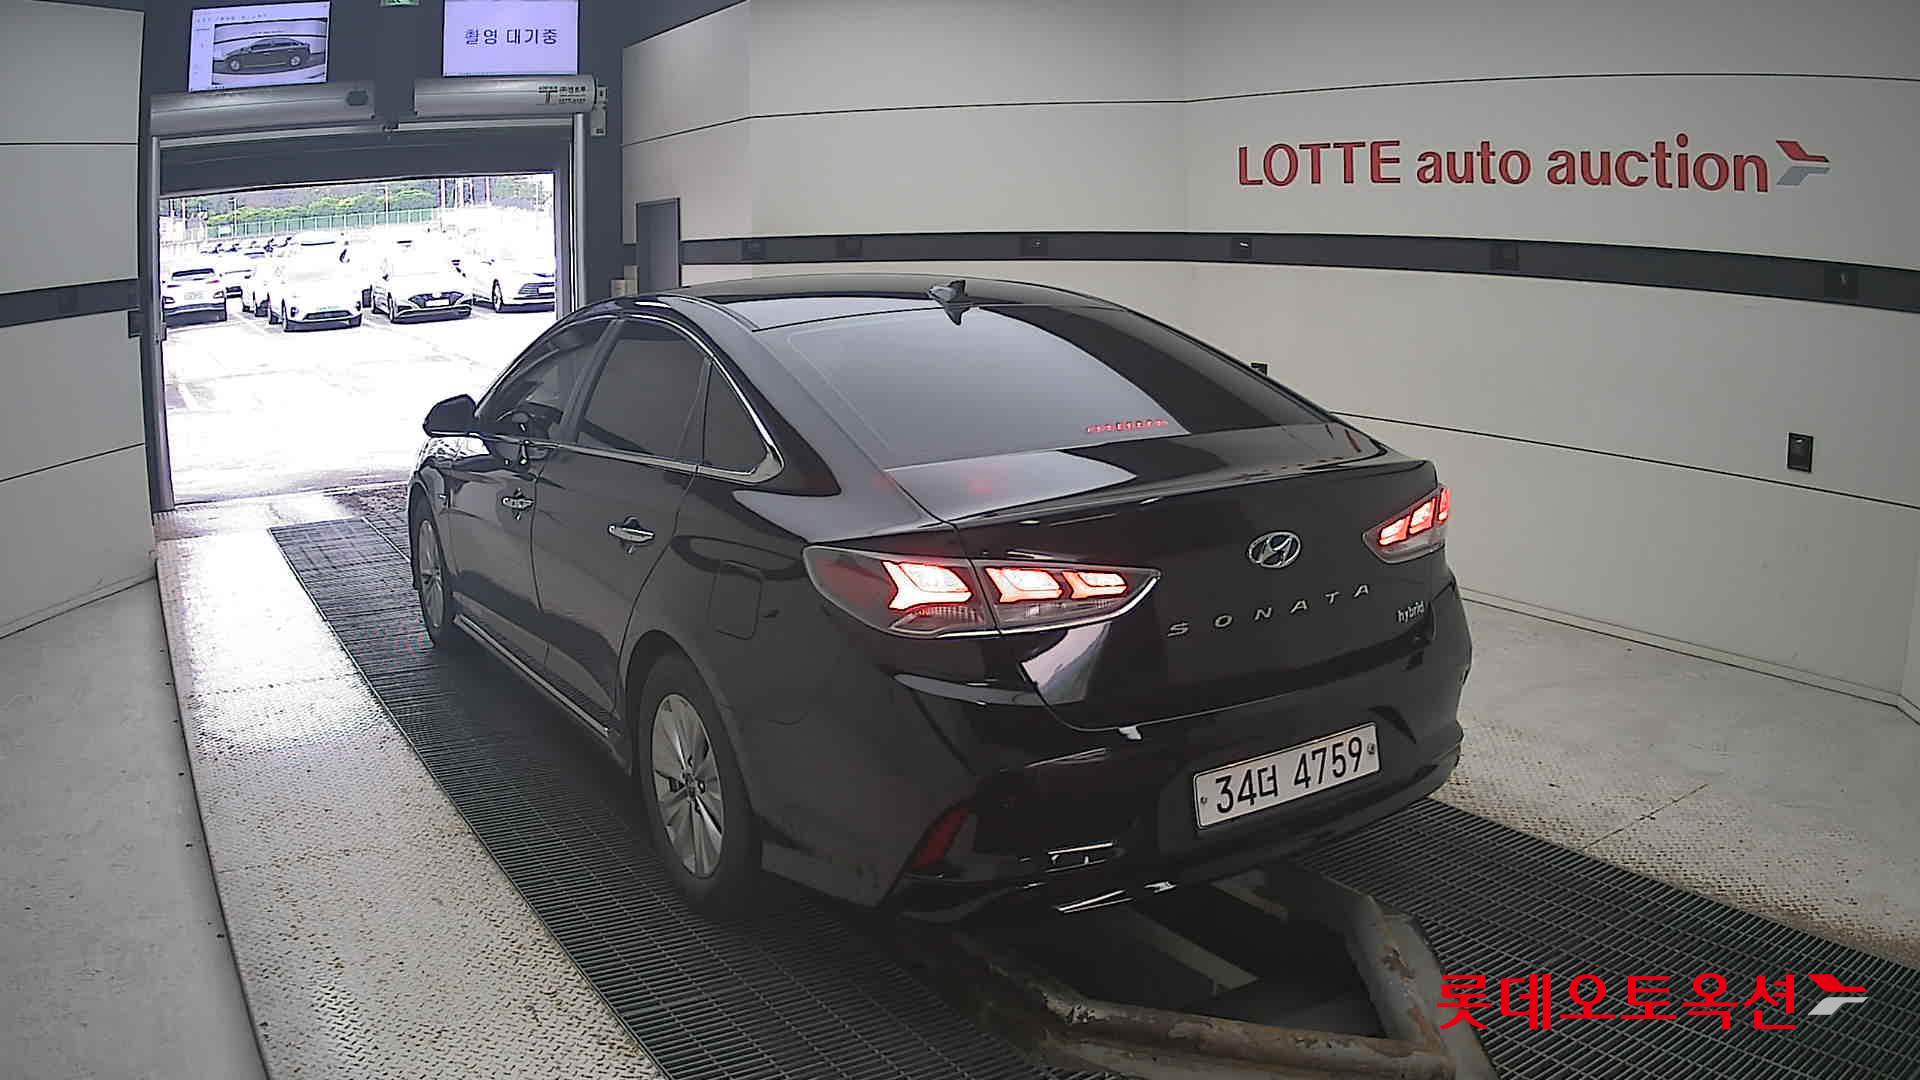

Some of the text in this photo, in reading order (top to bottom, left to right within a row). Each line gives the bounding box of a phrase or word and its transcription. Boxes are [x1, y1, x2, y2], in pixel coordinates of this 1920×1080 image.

[506, 28, 558, 46] 대기중
[1238, 133, 1768, 193] LOTTE auto auction
[1168, 584, 1369, 636] SONATA
[1397, 601, 1425, 623] hybrid
[1215, 736, 1363, 814] 34더 4759
